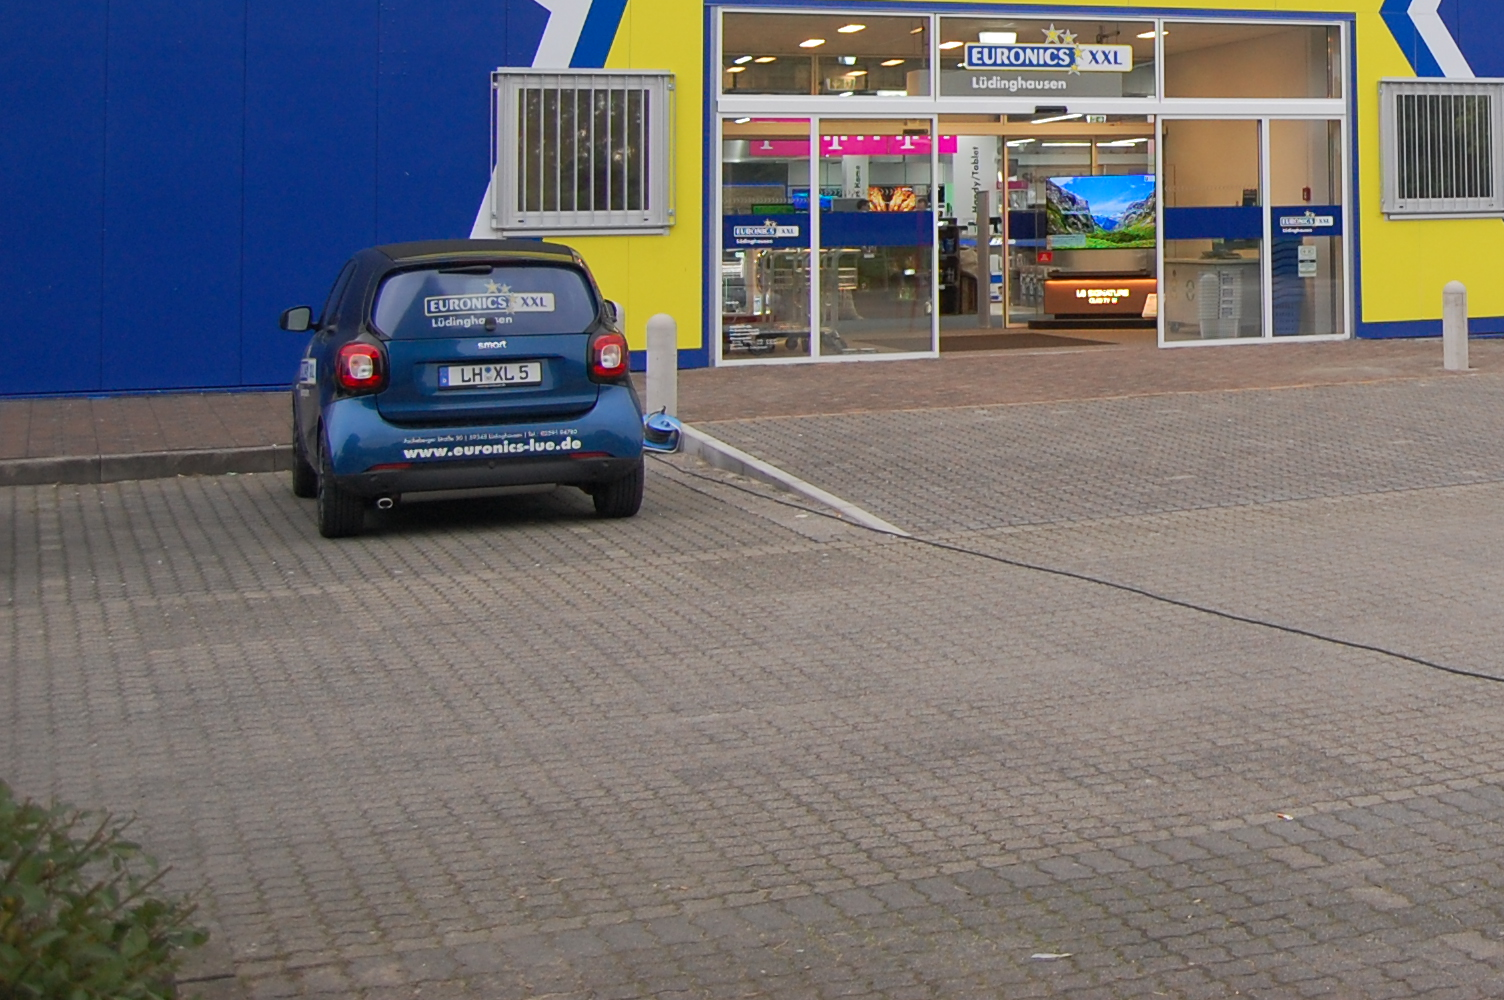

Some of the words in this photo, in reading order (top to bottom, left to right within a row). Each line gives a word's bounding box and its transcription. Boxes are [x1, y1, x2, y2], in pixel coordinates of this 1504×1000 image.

[972, 47, 1071, 65] EURONICS
[1088, 50, 1122, 65] XXL
[972, 76, 1067, 92] Lüdinghausen
[430, 296, 507, 312] EURONICS
[521, 296, 547, 308] XXL
[477, 340, 507, 349] smart
[461, 367, 482, 383] LH
[494, 365, 514, 381] XL
[519, 365, 529, 380] 5
[404, 436, 582, 459] www.euronics-lue.de
